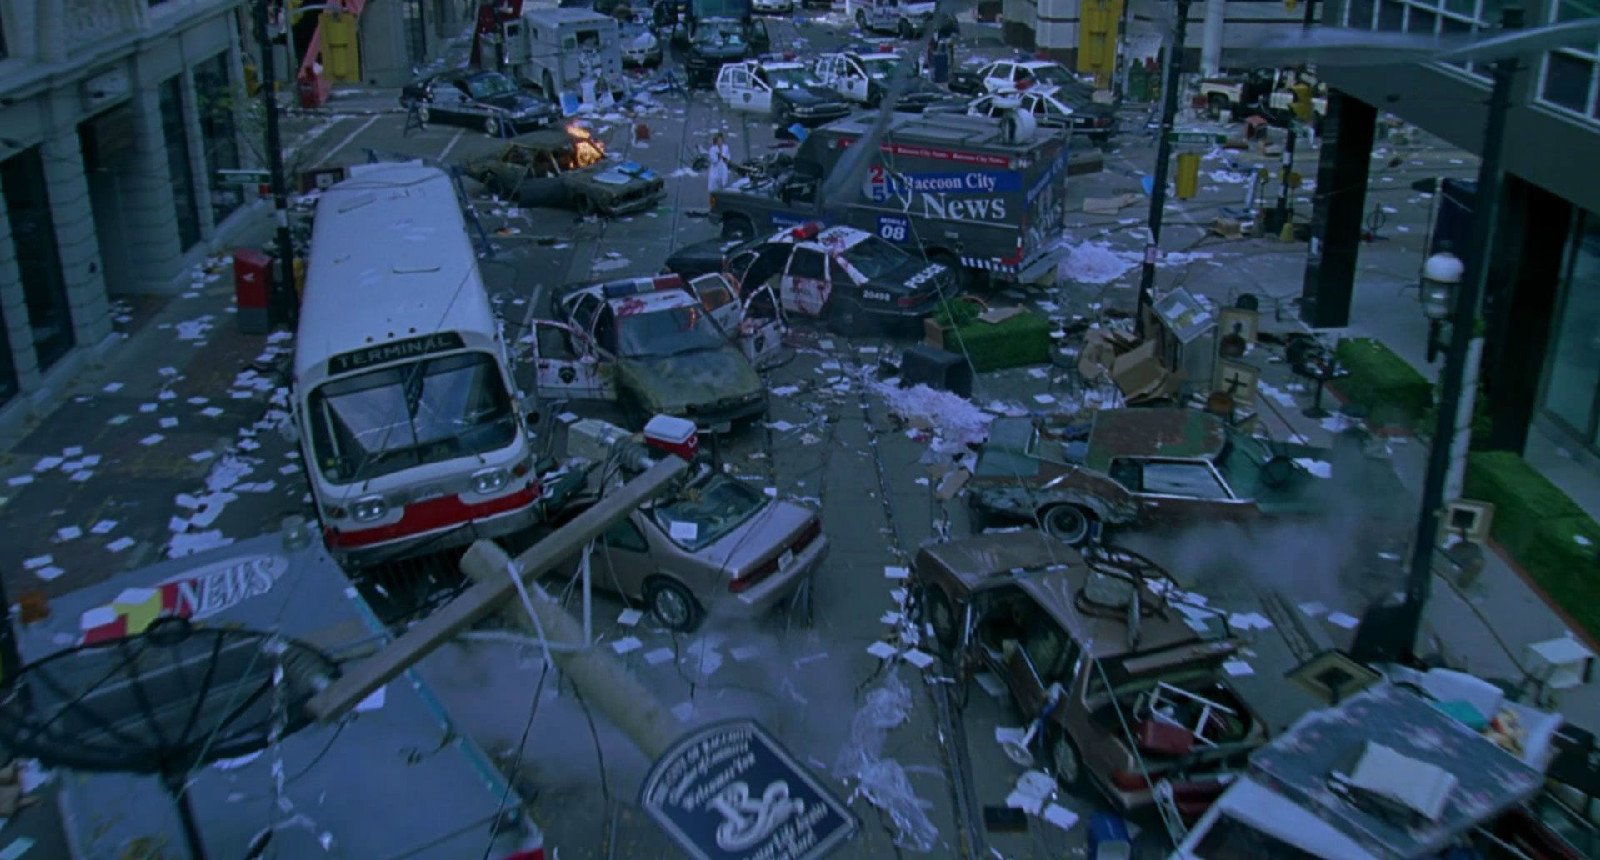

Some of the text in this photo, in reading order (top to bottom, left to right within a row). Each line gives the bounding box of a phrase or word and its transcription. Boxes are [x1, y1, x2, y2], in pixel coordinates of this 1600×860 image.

[901, 171, 997, 191] Raccoon City
[921, 192, 1006, 220] News
[880, 225, 906, 241] 08
[340, 335, 453, 369] TERMINAL
[171, 556, 275, 617] NEWS
